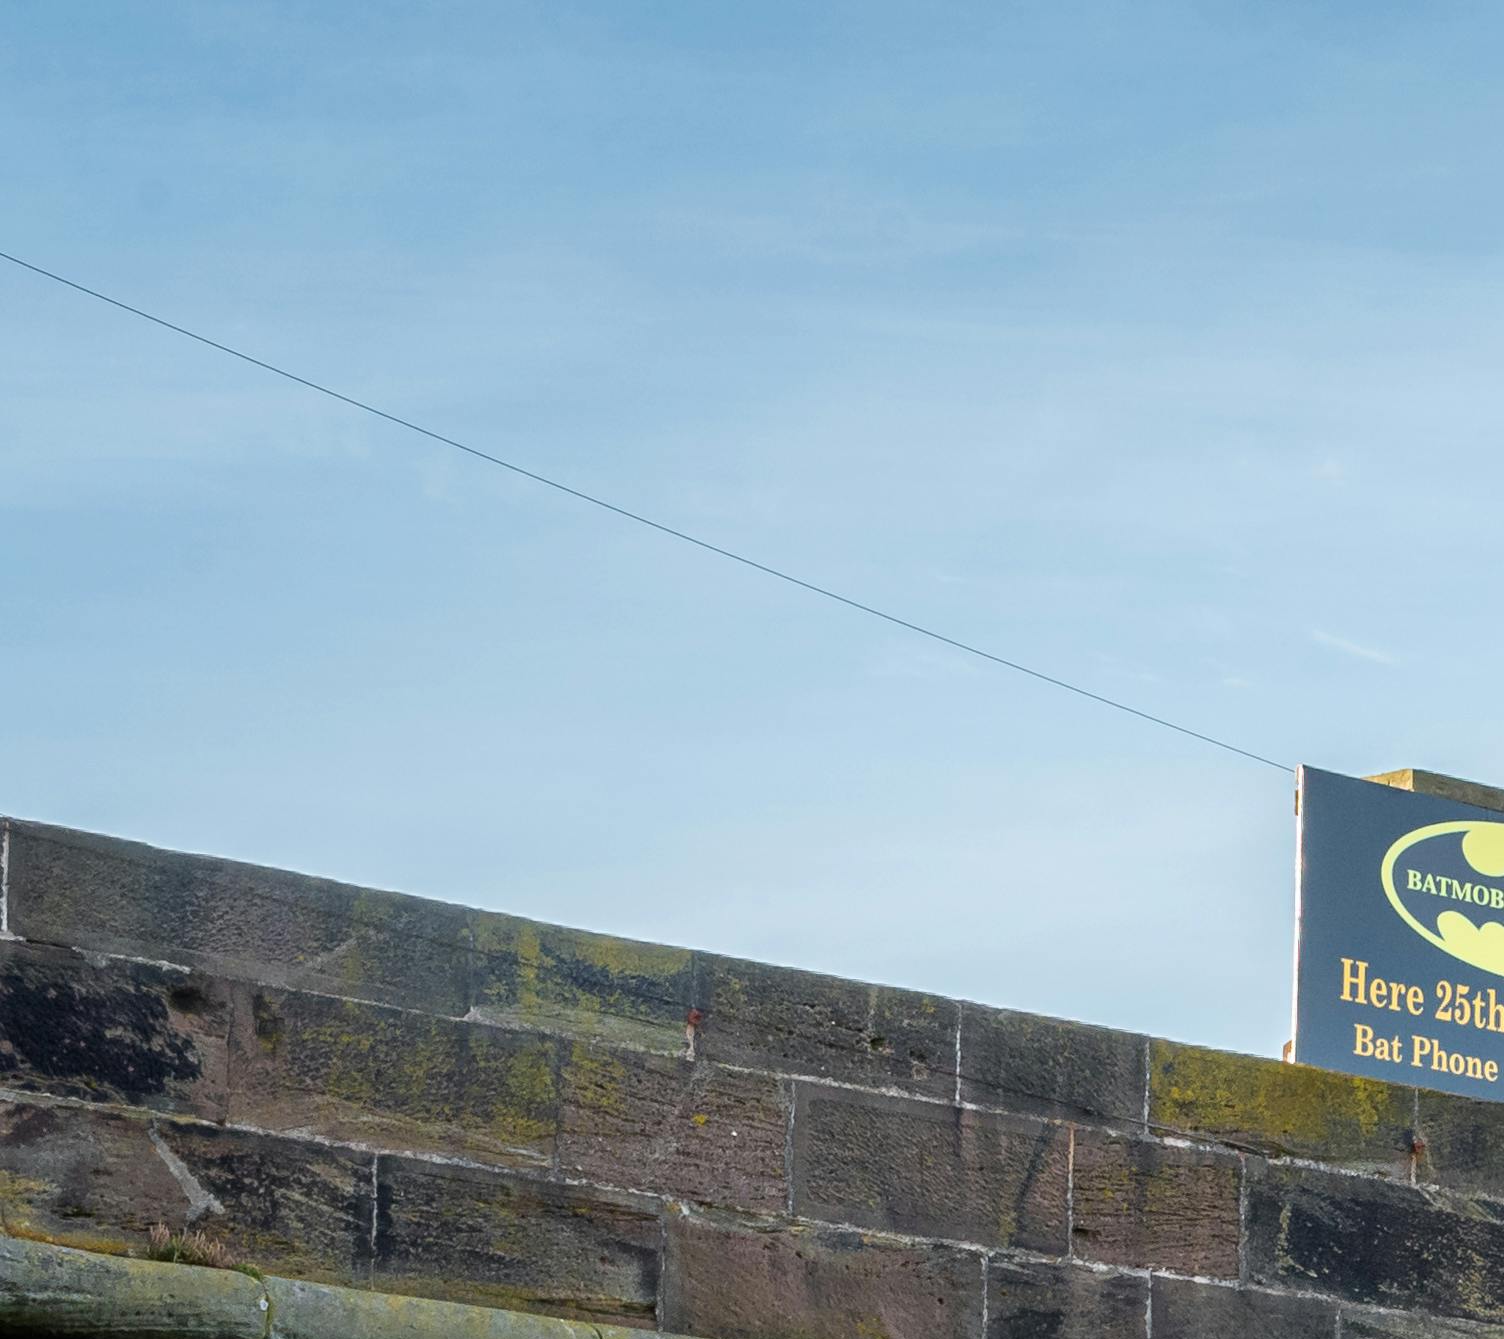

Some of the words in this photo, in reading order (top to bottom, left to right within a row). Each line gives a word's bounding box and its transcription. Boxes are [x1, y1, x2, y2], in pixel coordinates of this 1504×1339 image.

[1340, 957, 1425, 1016] Here
[1353, 1023, 1402, 1063] Bat
[1410, 1035, 1498, 1082] Phone
